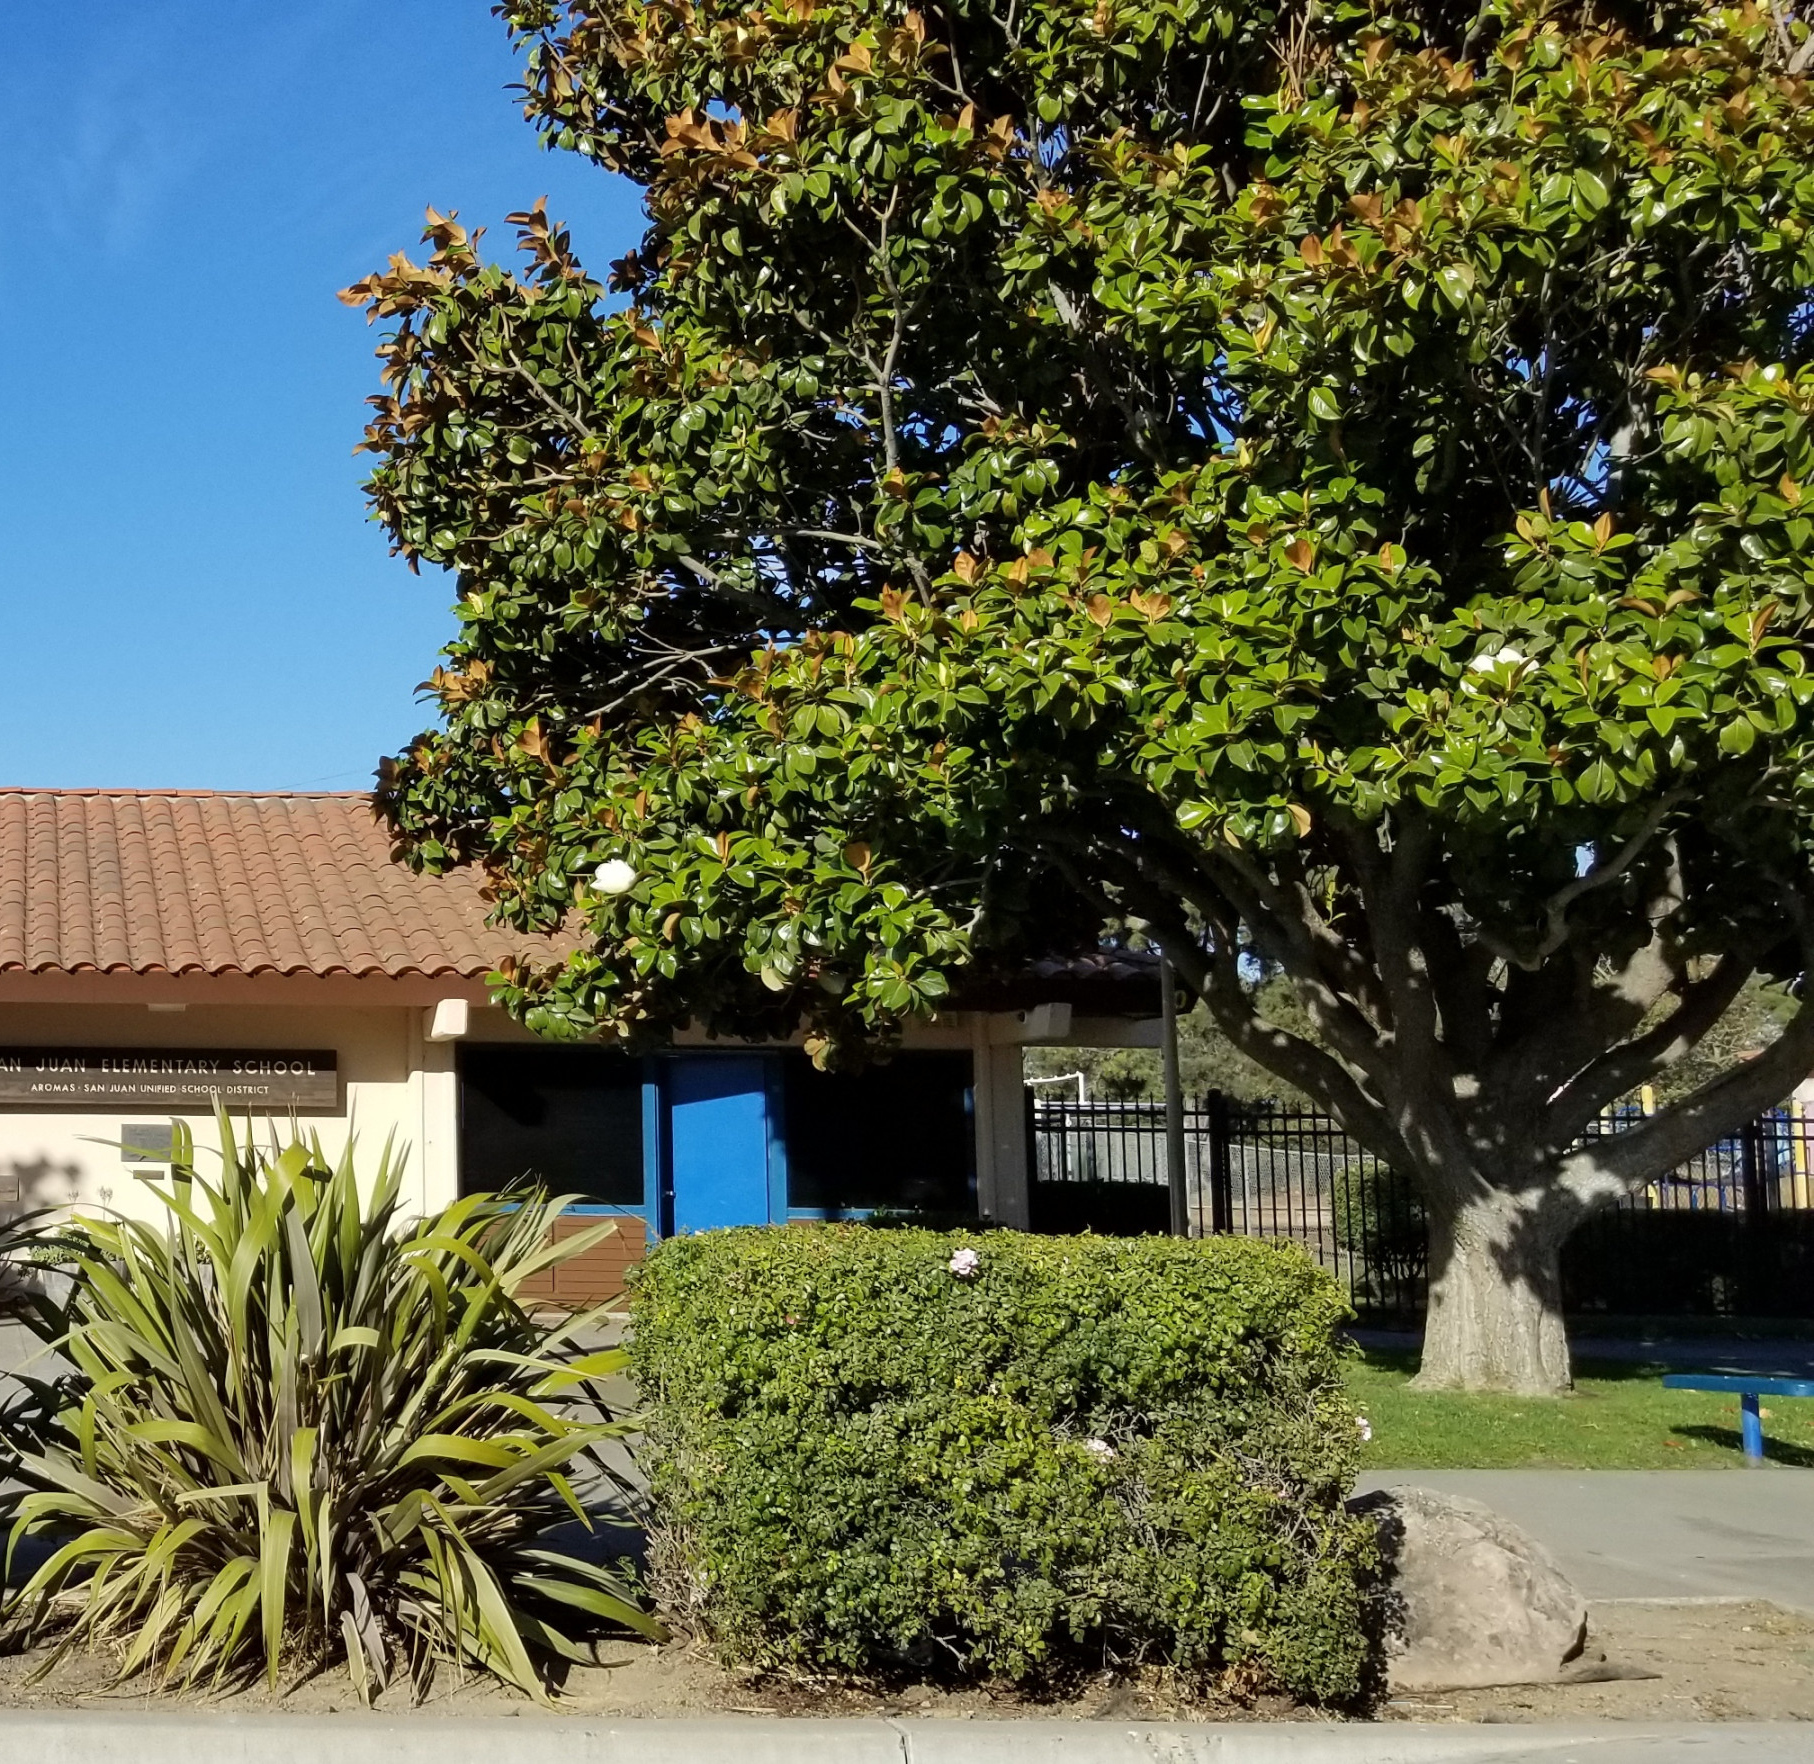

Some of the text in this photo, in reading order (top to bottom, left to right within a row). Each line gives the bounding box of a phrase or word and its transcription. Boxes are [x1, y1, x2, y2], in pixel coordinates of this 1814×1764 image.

[36, 1058, 86, 1073] JUAN
[101, 1058, 220, 1074] ELEMENTARY
[232, 1060, 316, 1075] SCHOOL
[31, 1083, 269, 1094] AROMAS SAN JUAN UNIFIED SCHOOL DISTRICT
